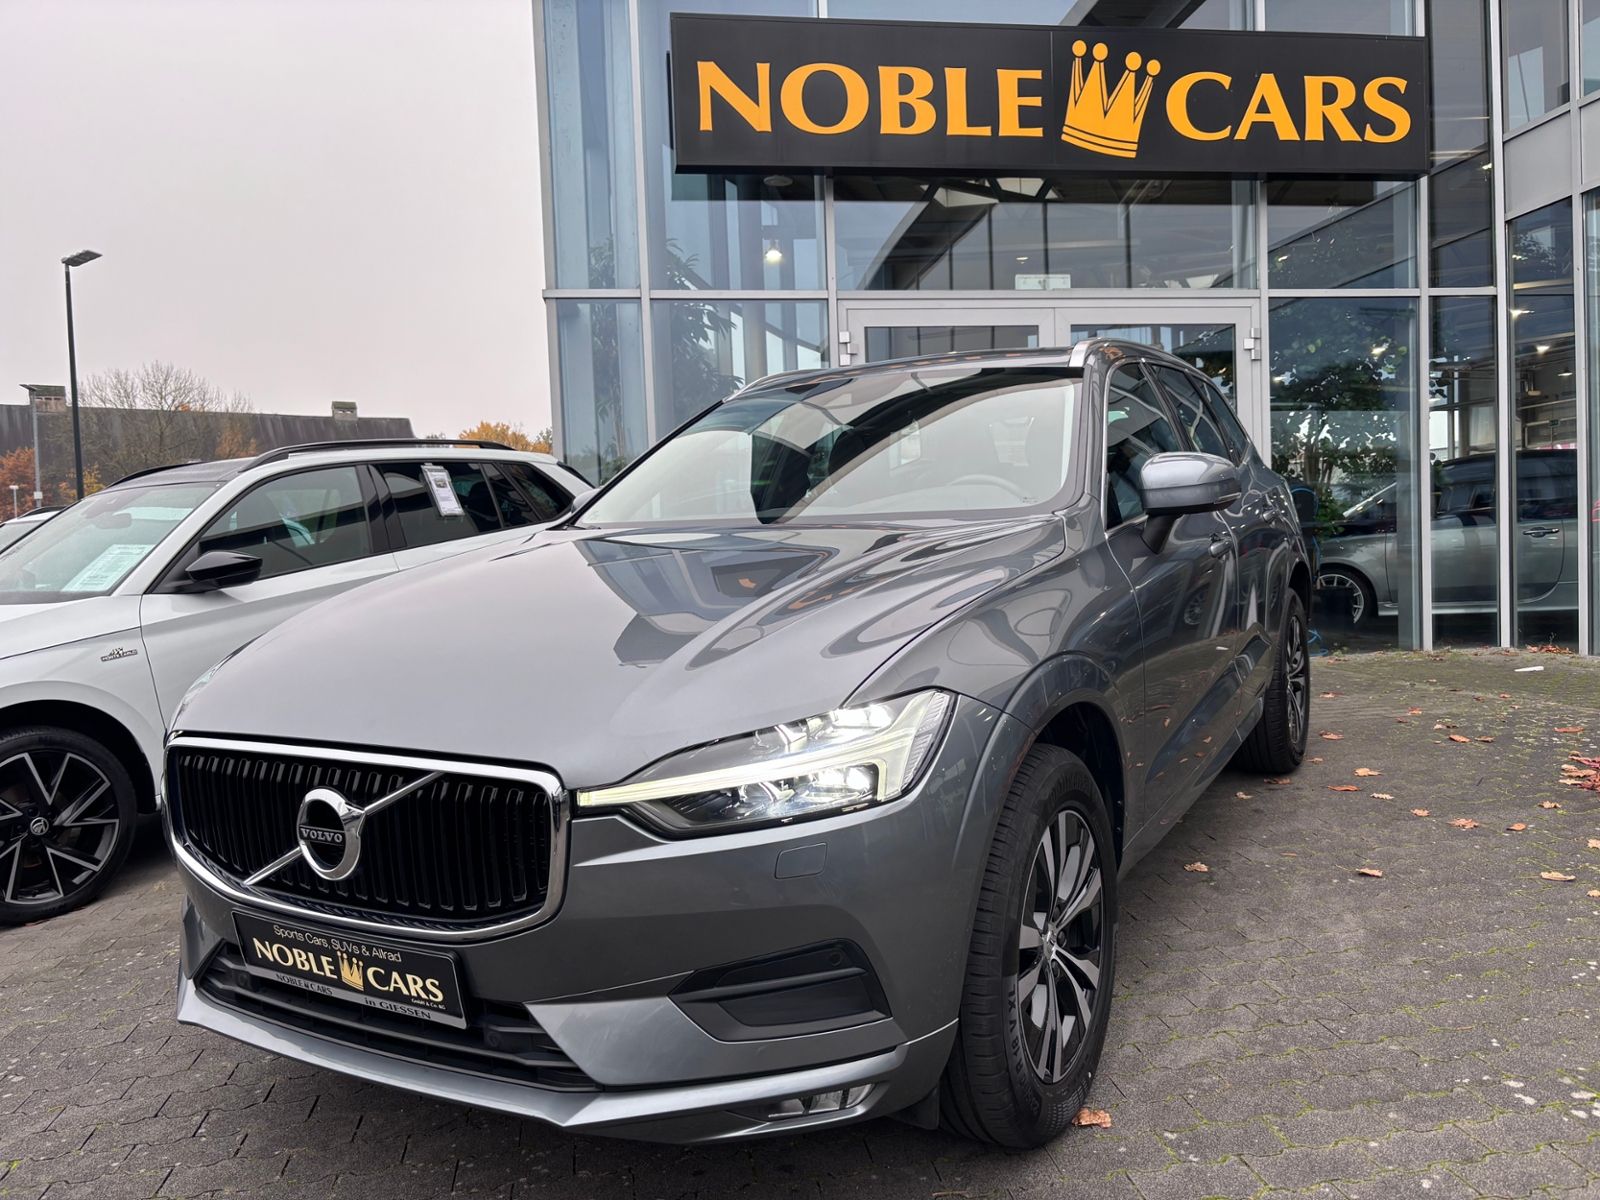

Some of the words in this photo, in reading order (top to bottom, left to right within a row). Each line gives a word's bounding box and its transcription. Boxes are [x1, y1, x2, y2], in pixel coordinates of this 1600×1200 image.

[697, 61, 1044, 137] NOBLE
[1165, 71, 1412, 143] CARS
[300, 828, 343, 843] VOLVO
[273, 925, 304, 941] Sports
[305, 932, 331, 950] Cars,
[331, 938, 360, 954] SUVs
[361, 944, 370, 957] &
[372, 947, 402, 962] Allrad
[252, 937, 338, 979] NOBLE
[366, 966, 444, 1002] CARS
[275, 973, 303, 988] NOBLE
[310, 983, 333, 996] CARS
[364, 996, 376, 1007] in
[379, 1000, 431, 1019] GIESSEN
